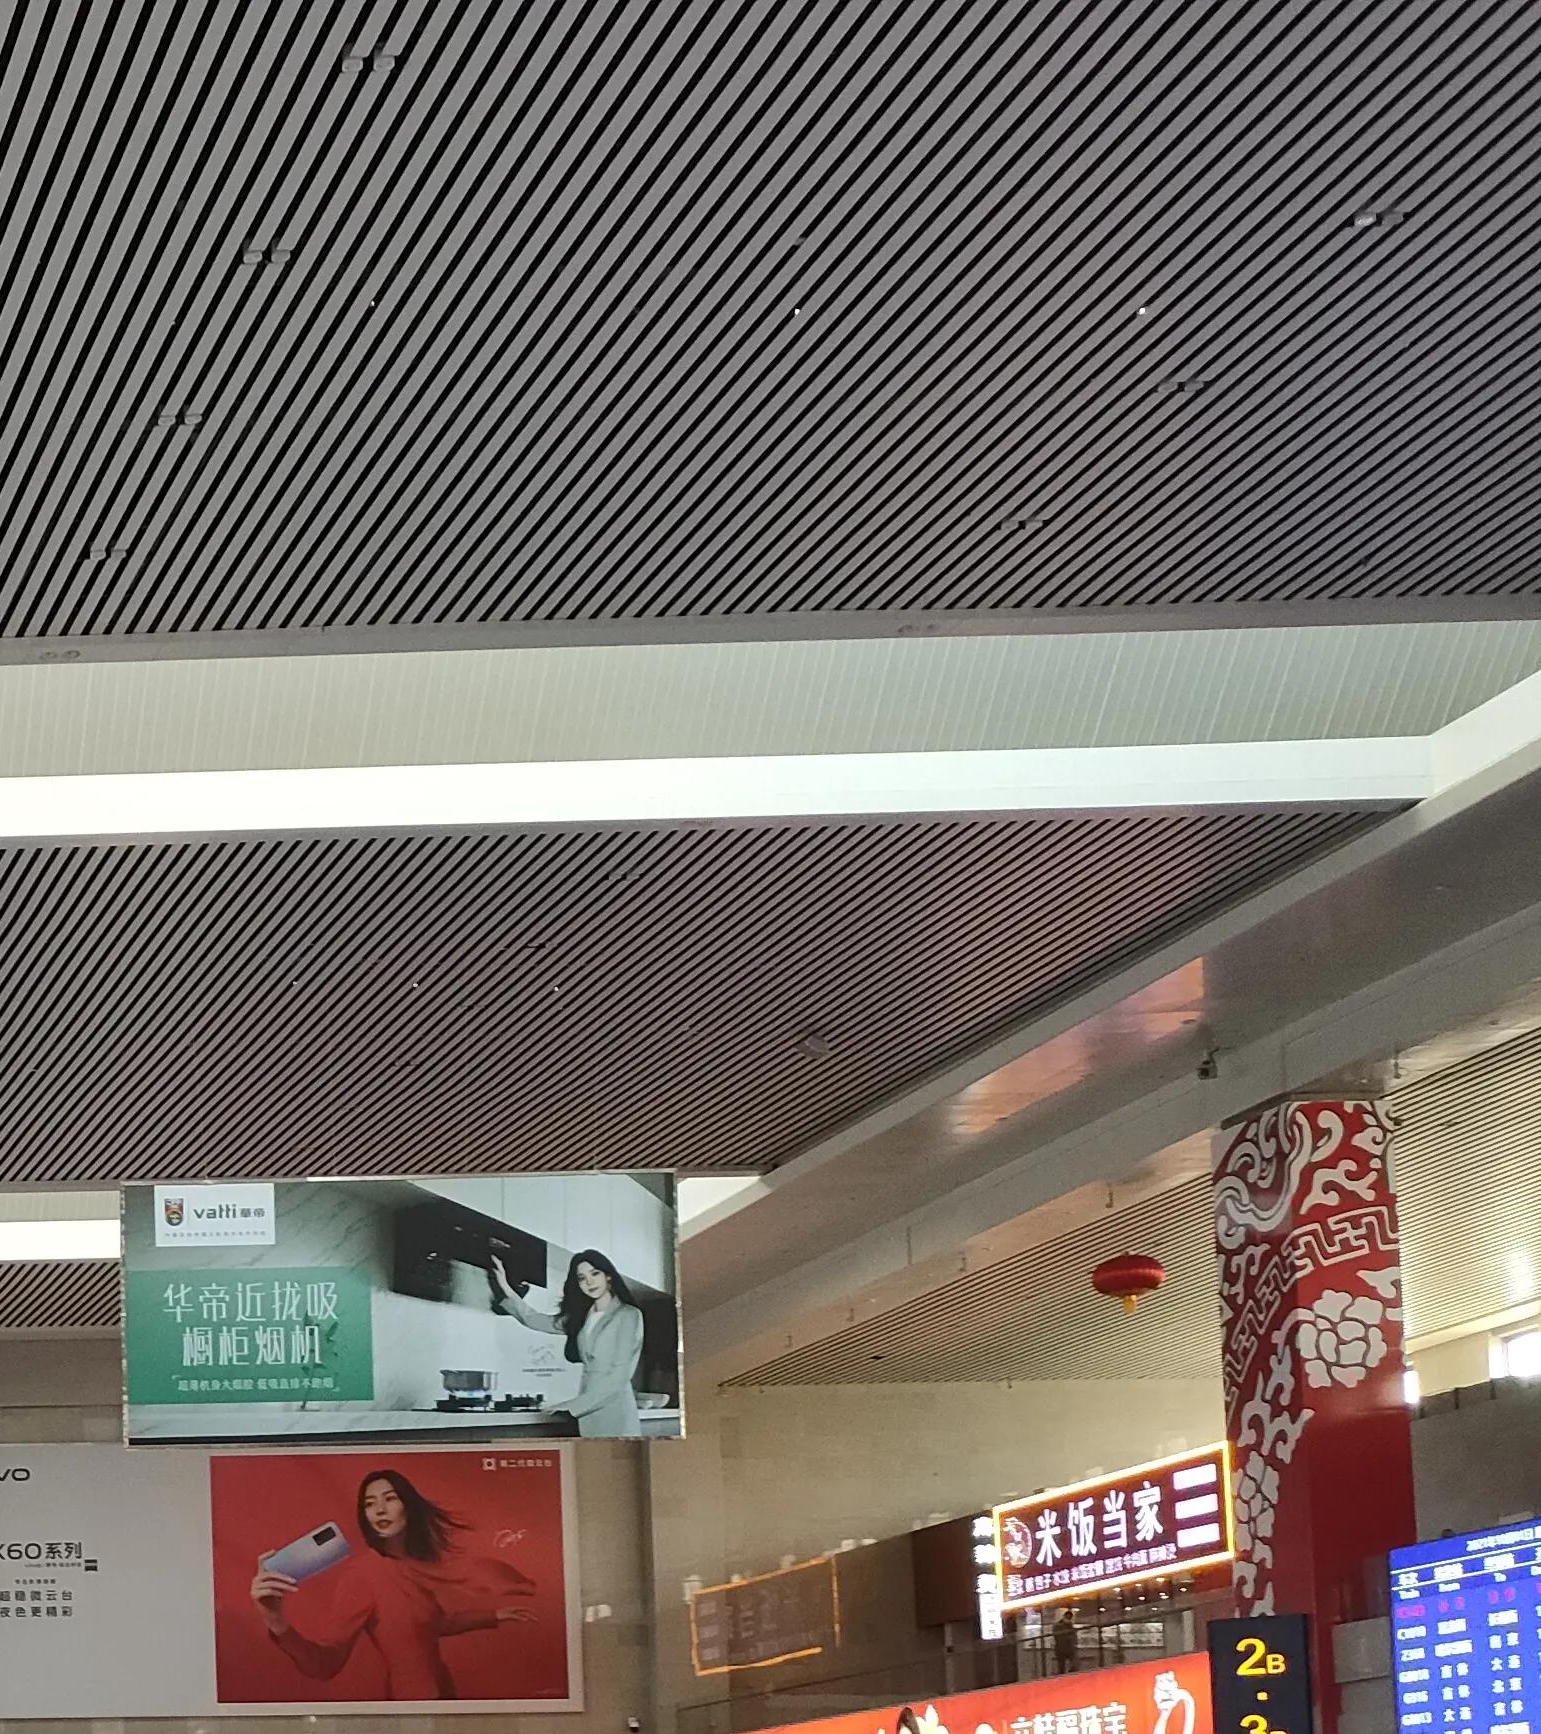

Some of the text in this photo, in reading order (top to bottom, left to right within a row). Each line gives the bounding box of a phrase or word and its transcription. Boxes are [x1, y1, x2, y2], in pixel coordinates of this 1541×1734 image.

[194, 1204, 237, 1219] vatti
[163, 1281, 339, 1323] 华帝近拢吸
[182, 1325, 323, 1366] 橱柜烟机
[1035, 1480, 1164, 1567] 米饭当家
[0, 1606, 73, 1618] 夜色更精彩
[1235, 1637, 1287, 1677] 2B
